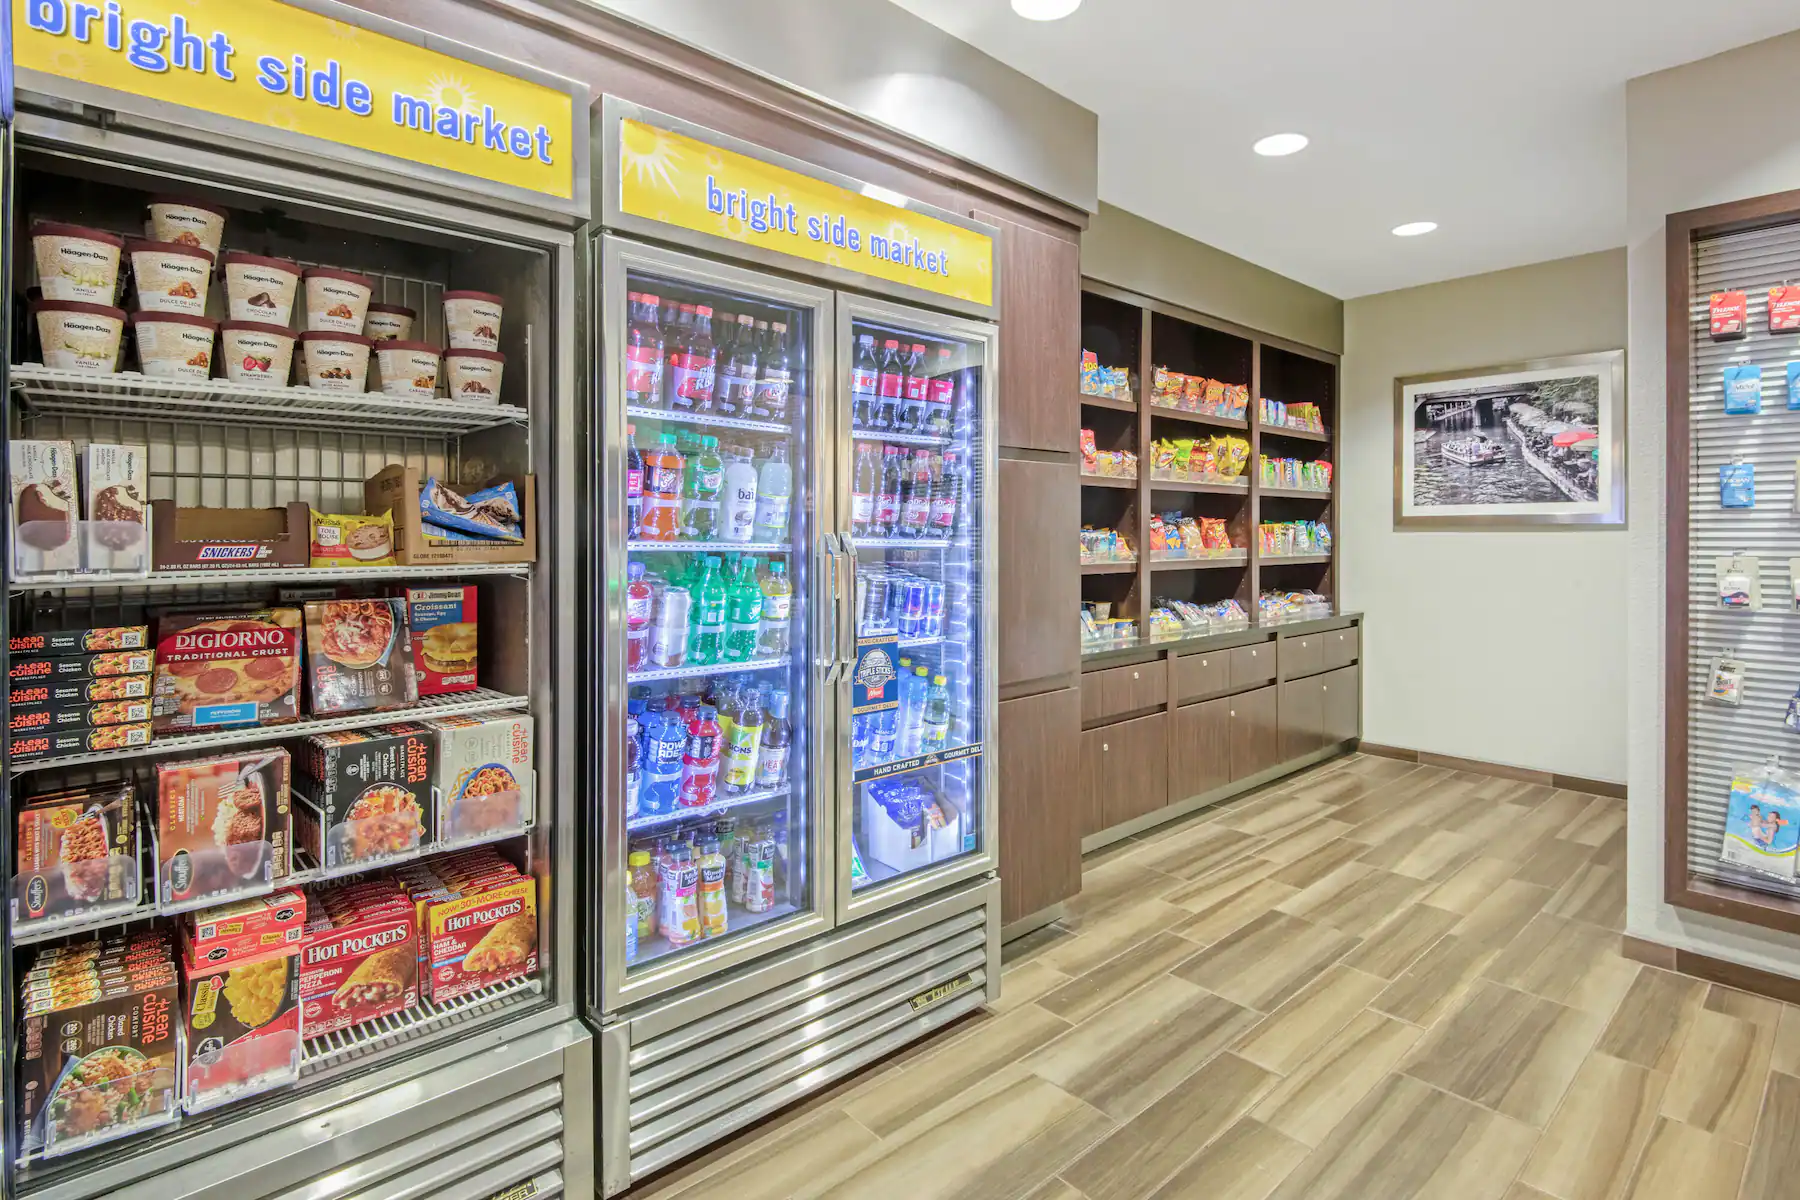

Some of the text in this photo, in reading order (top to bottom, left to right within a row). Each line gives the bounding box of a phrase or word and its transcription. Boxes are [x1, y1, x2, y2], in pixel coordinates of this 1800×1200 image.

[28, 0, 554, 164] bright side market
[706, 175, 949, 277] bright side market
[738, 488, 754, 500] bai
[201, 547, 255, 558] SNICKERS
[415, 603, 457, 611] Croissant
[175, 629, 284, 650] DIGIORNO
[167, 648, 289, 661] TRADITIONAL CRUST
[9, 666, 52, 677] cuisine
[860, 666, 892, 677] TRIPLE STICKS
[512, 724, 520, 764] cuisine
[407, 738, 417, 784] cuisine
[944, 750, 969, 759] GOURMET
[874, 759, 920, 776] HAND CRAFTED
[476, 891, 502, 904] MORE
[504, 887, 528, 896] CHEESE
[448, 900, 521, 931] HOT POCKETS
[308, 924, 407, 964] HOT POCKETS
[433, 941, 450, 950] HAM
[434, 942, 467, 956] CHEDDAR
[527, 958, 536, 968] 2
[300, 967, 342, 983] PEPPERONI
[299, 980, 322, 990] PIZZA
[196, 983, 210, 1011] Classic
[405, 992, 416, 1005] 2
[118, 1015, 126, 1036] Glazed
[142, 993, 156, 1044] cuisine
[107, 1015, 116, 1040] Chicken
